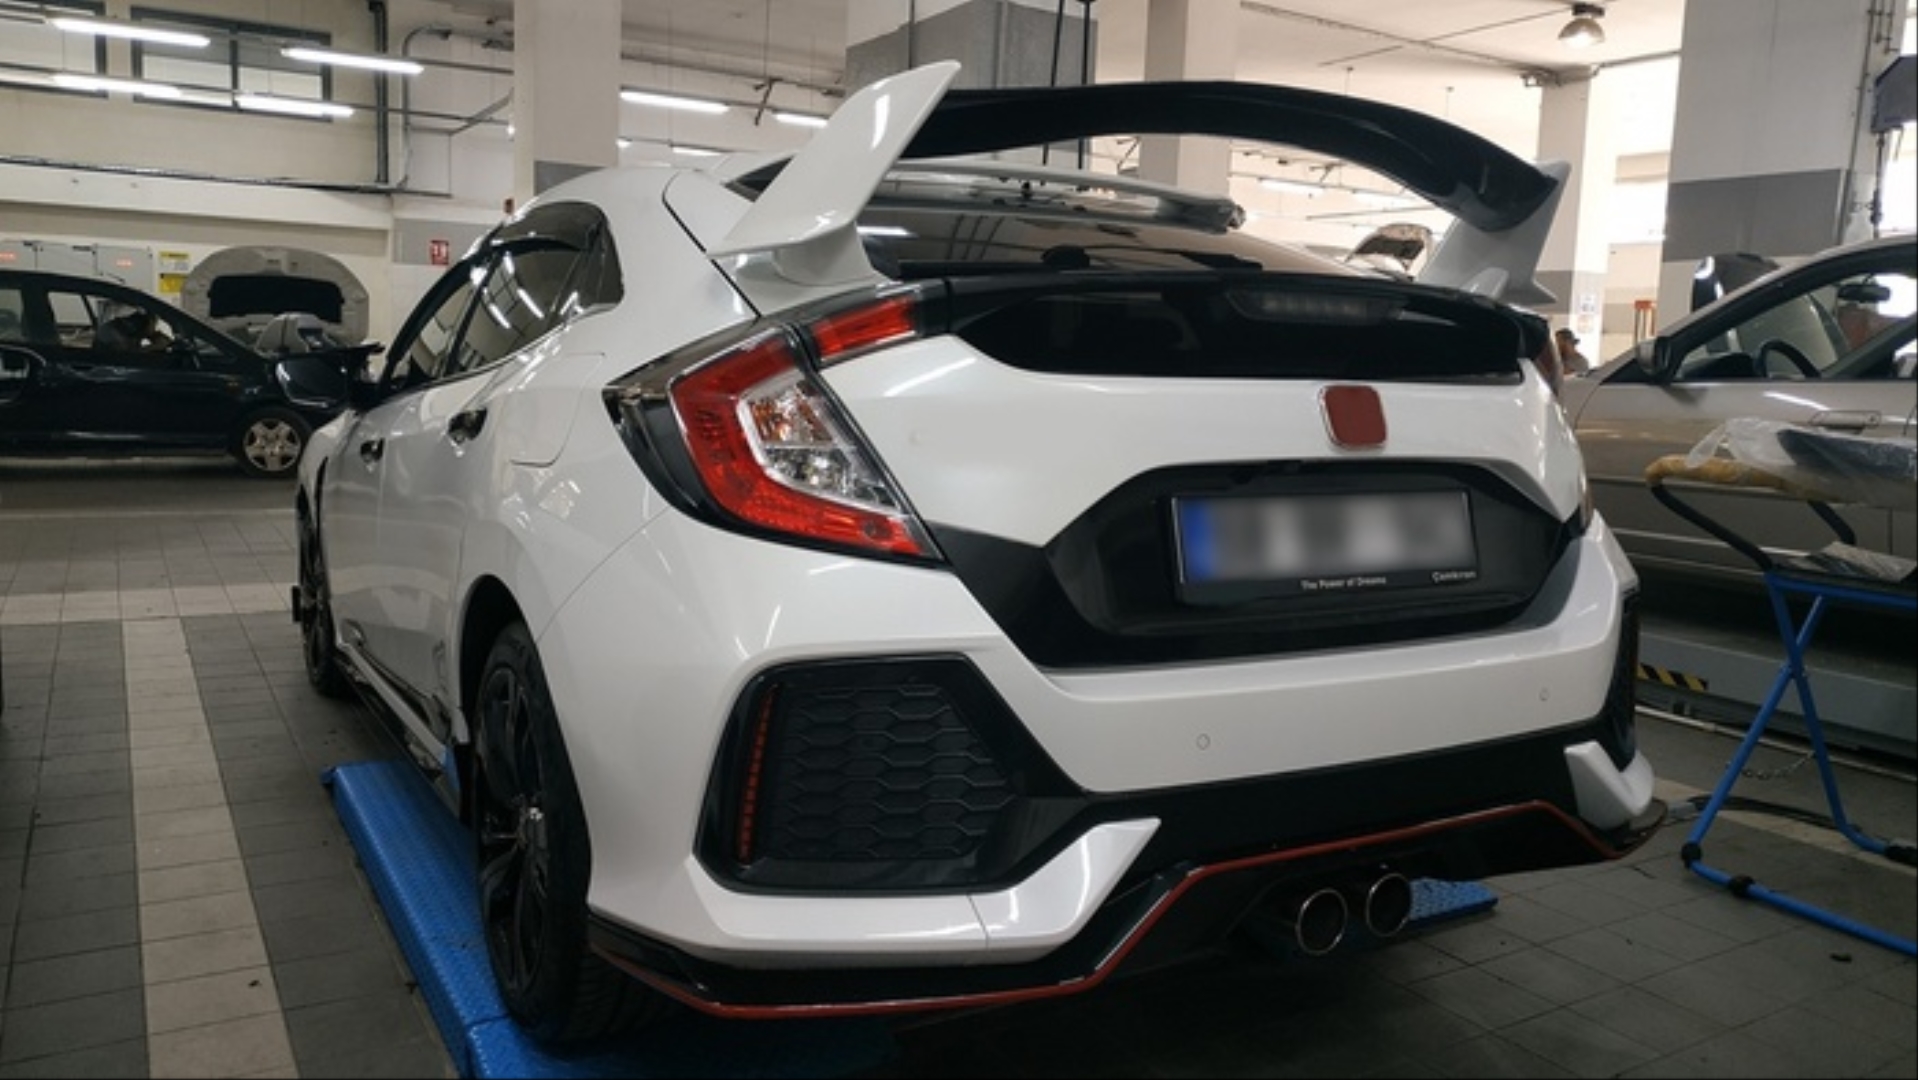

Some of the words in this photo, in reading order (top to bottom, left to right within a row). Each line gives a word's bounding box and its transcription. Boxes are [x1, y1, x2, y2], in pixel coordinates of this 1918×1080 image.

[1301, 580, 1318, 590] The
[1319, 579, 1345, 589] Power
[1358, 577, 1386, 586] Dreams
